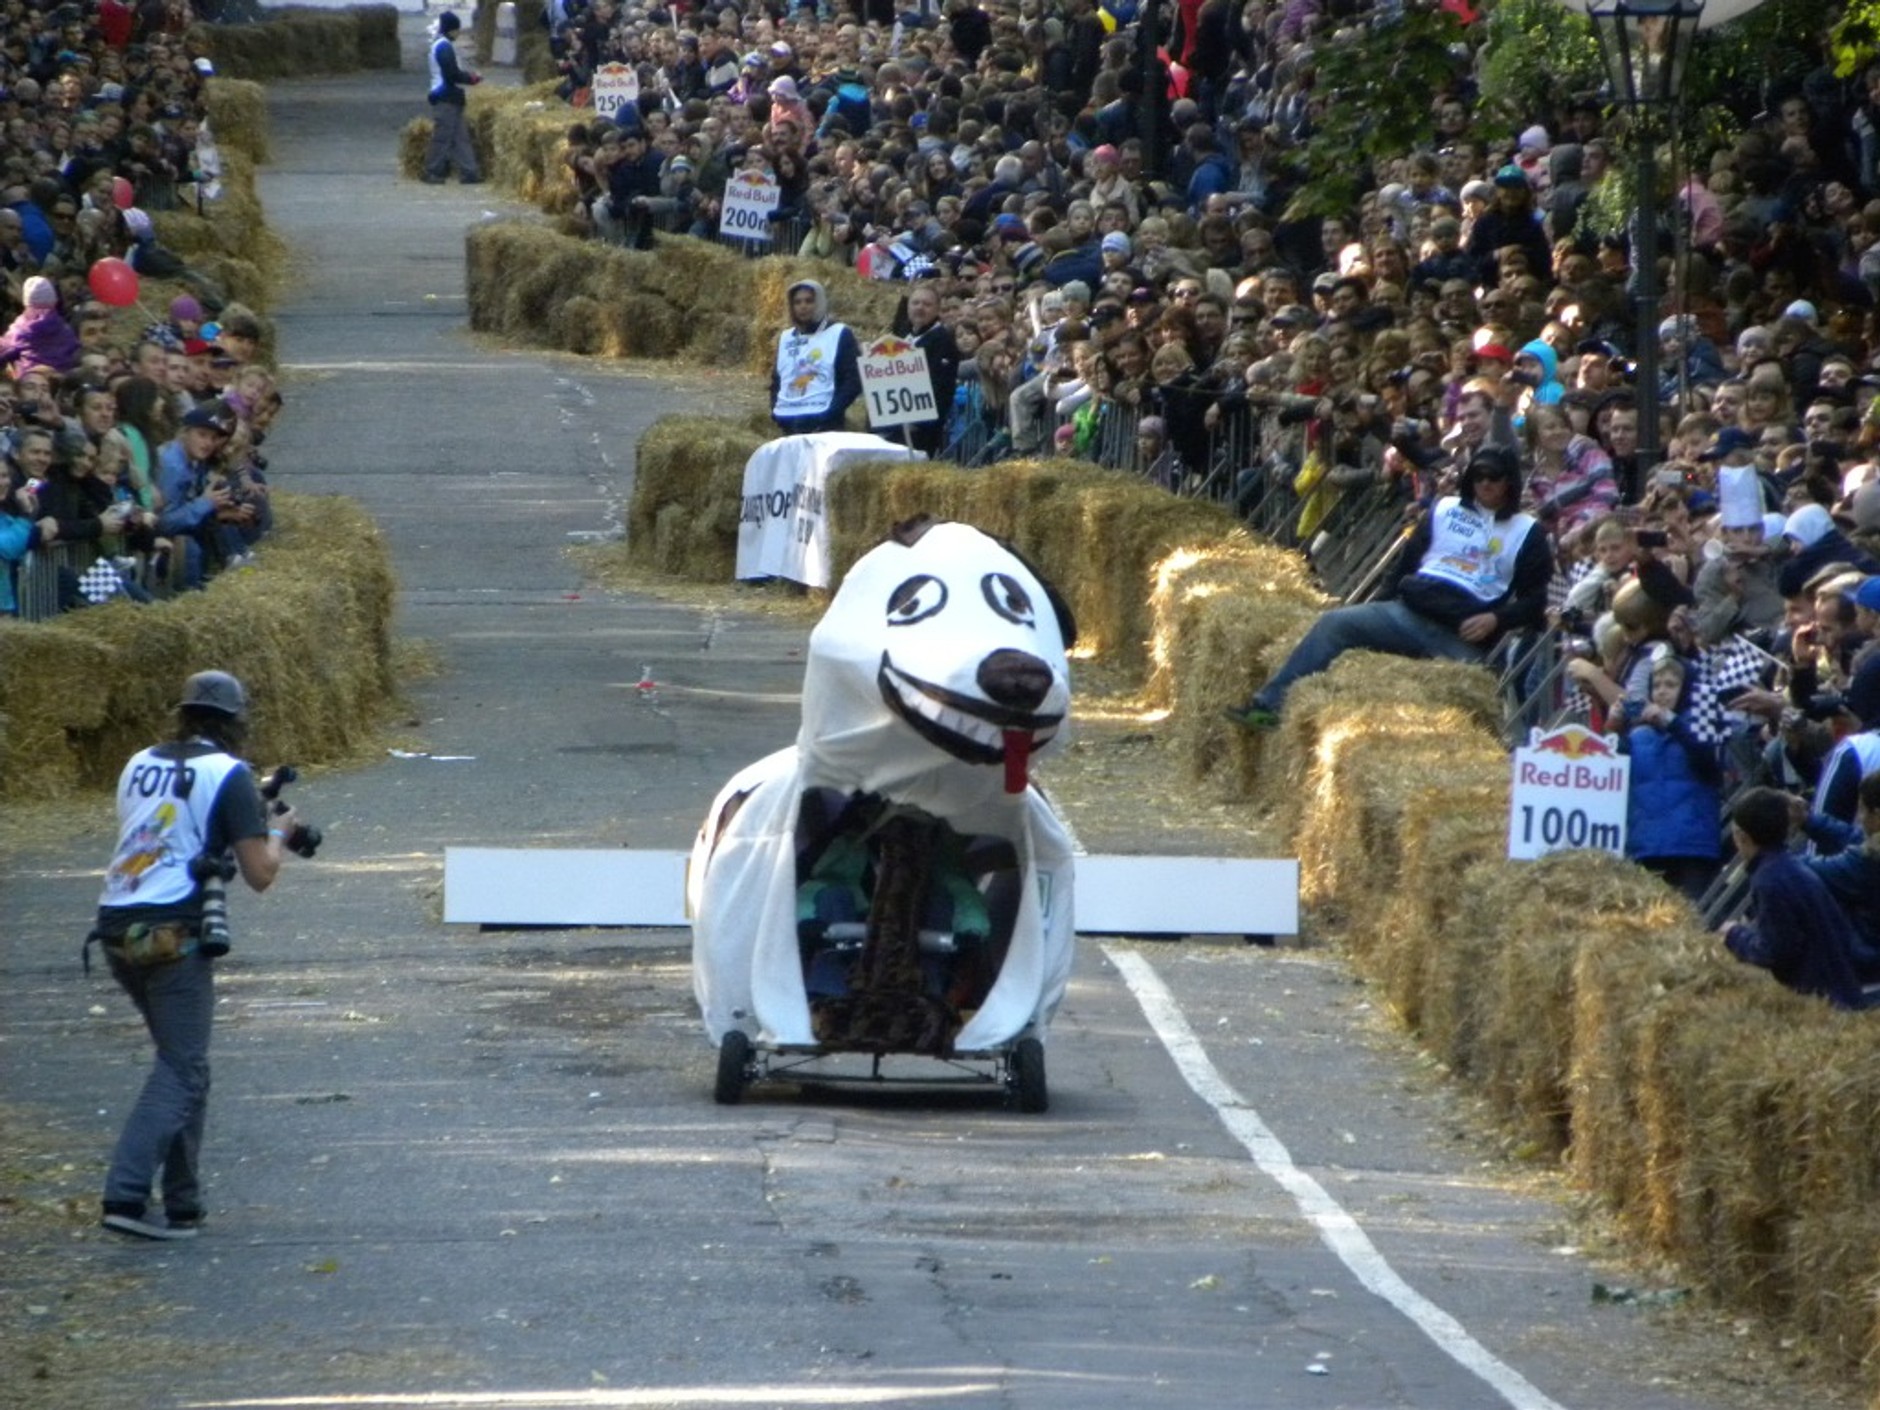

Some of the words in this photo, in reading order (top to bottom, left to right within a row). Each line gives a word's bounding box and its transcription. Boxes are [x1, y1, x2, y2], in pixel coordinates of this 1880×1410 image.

[729, 186, 752, 200] Red
[753, 189, 776, 204] Bull
[864, 361, 895, 379] Red
[896, 356, 925, 374] Bull
[872, 387, 933, 416] 150m
[1520, 762, 1570, 788] Red
[1574, 765, 1623, 792] Bull
[1522, 805, 1620, 850] 100m
